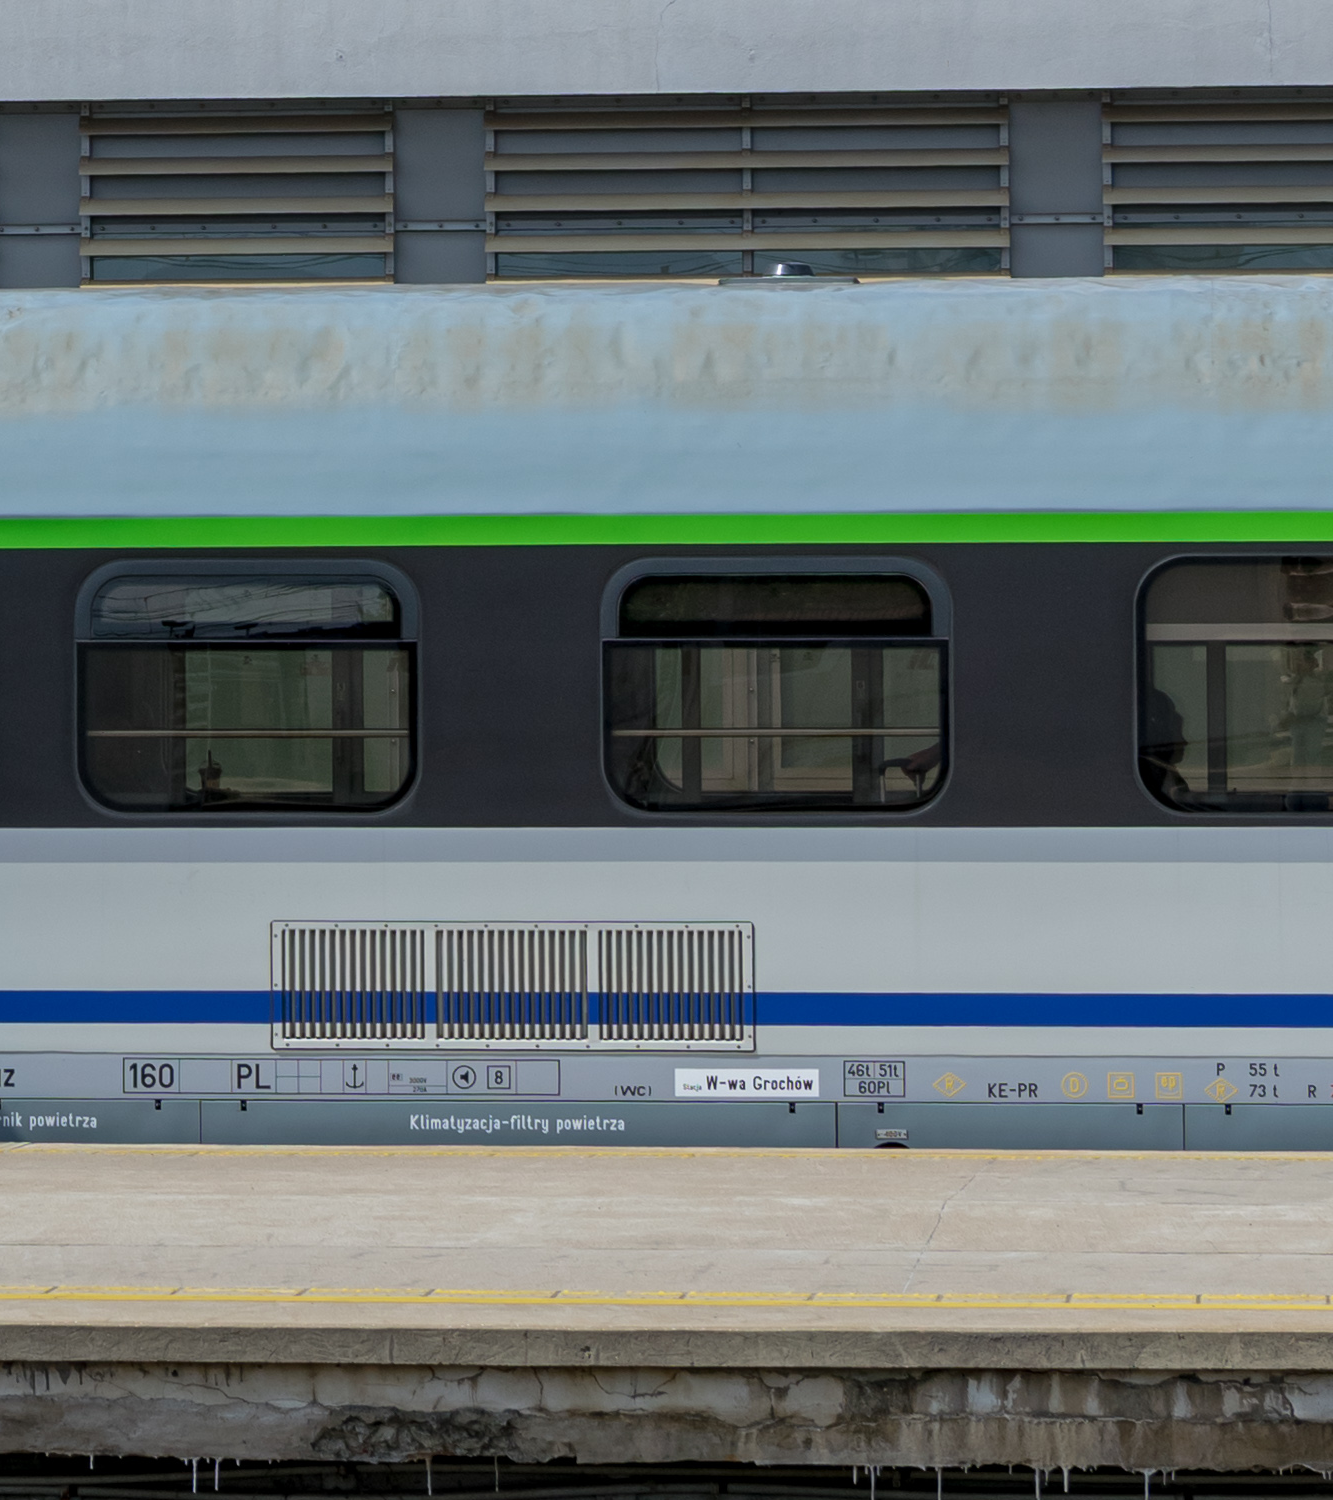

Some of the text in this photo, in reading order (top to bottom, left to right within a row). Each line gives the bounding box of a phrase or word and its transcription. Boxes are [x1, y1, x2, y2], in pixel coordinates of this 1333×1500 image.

[129, 1062, 175, 1089] 160
[236, 1063, 271, 1090] PL
[847, 1063, 900, 1078] 46t 51t
[1216, 1062, 1280, 1077] P 55 t
[494, 1070, 503, 1085] 8
[706, 1075, 746, 1091] W-wa
[752, 1075, 814, 1091] Grochów
[614, 1085, 652, 1097] (WC)
[987, 1082, 1038, 1099] KE-PR
[1249, 1084, 1267, 1098] 73
[1273, 1084, 1279, 1098] t
[1307, 1084, 1317, 1098] R
[29, 1111, 97, 1131] powietrza
[409, 1113, 625, 1135] Klimatyzacja-filtry powietrza
